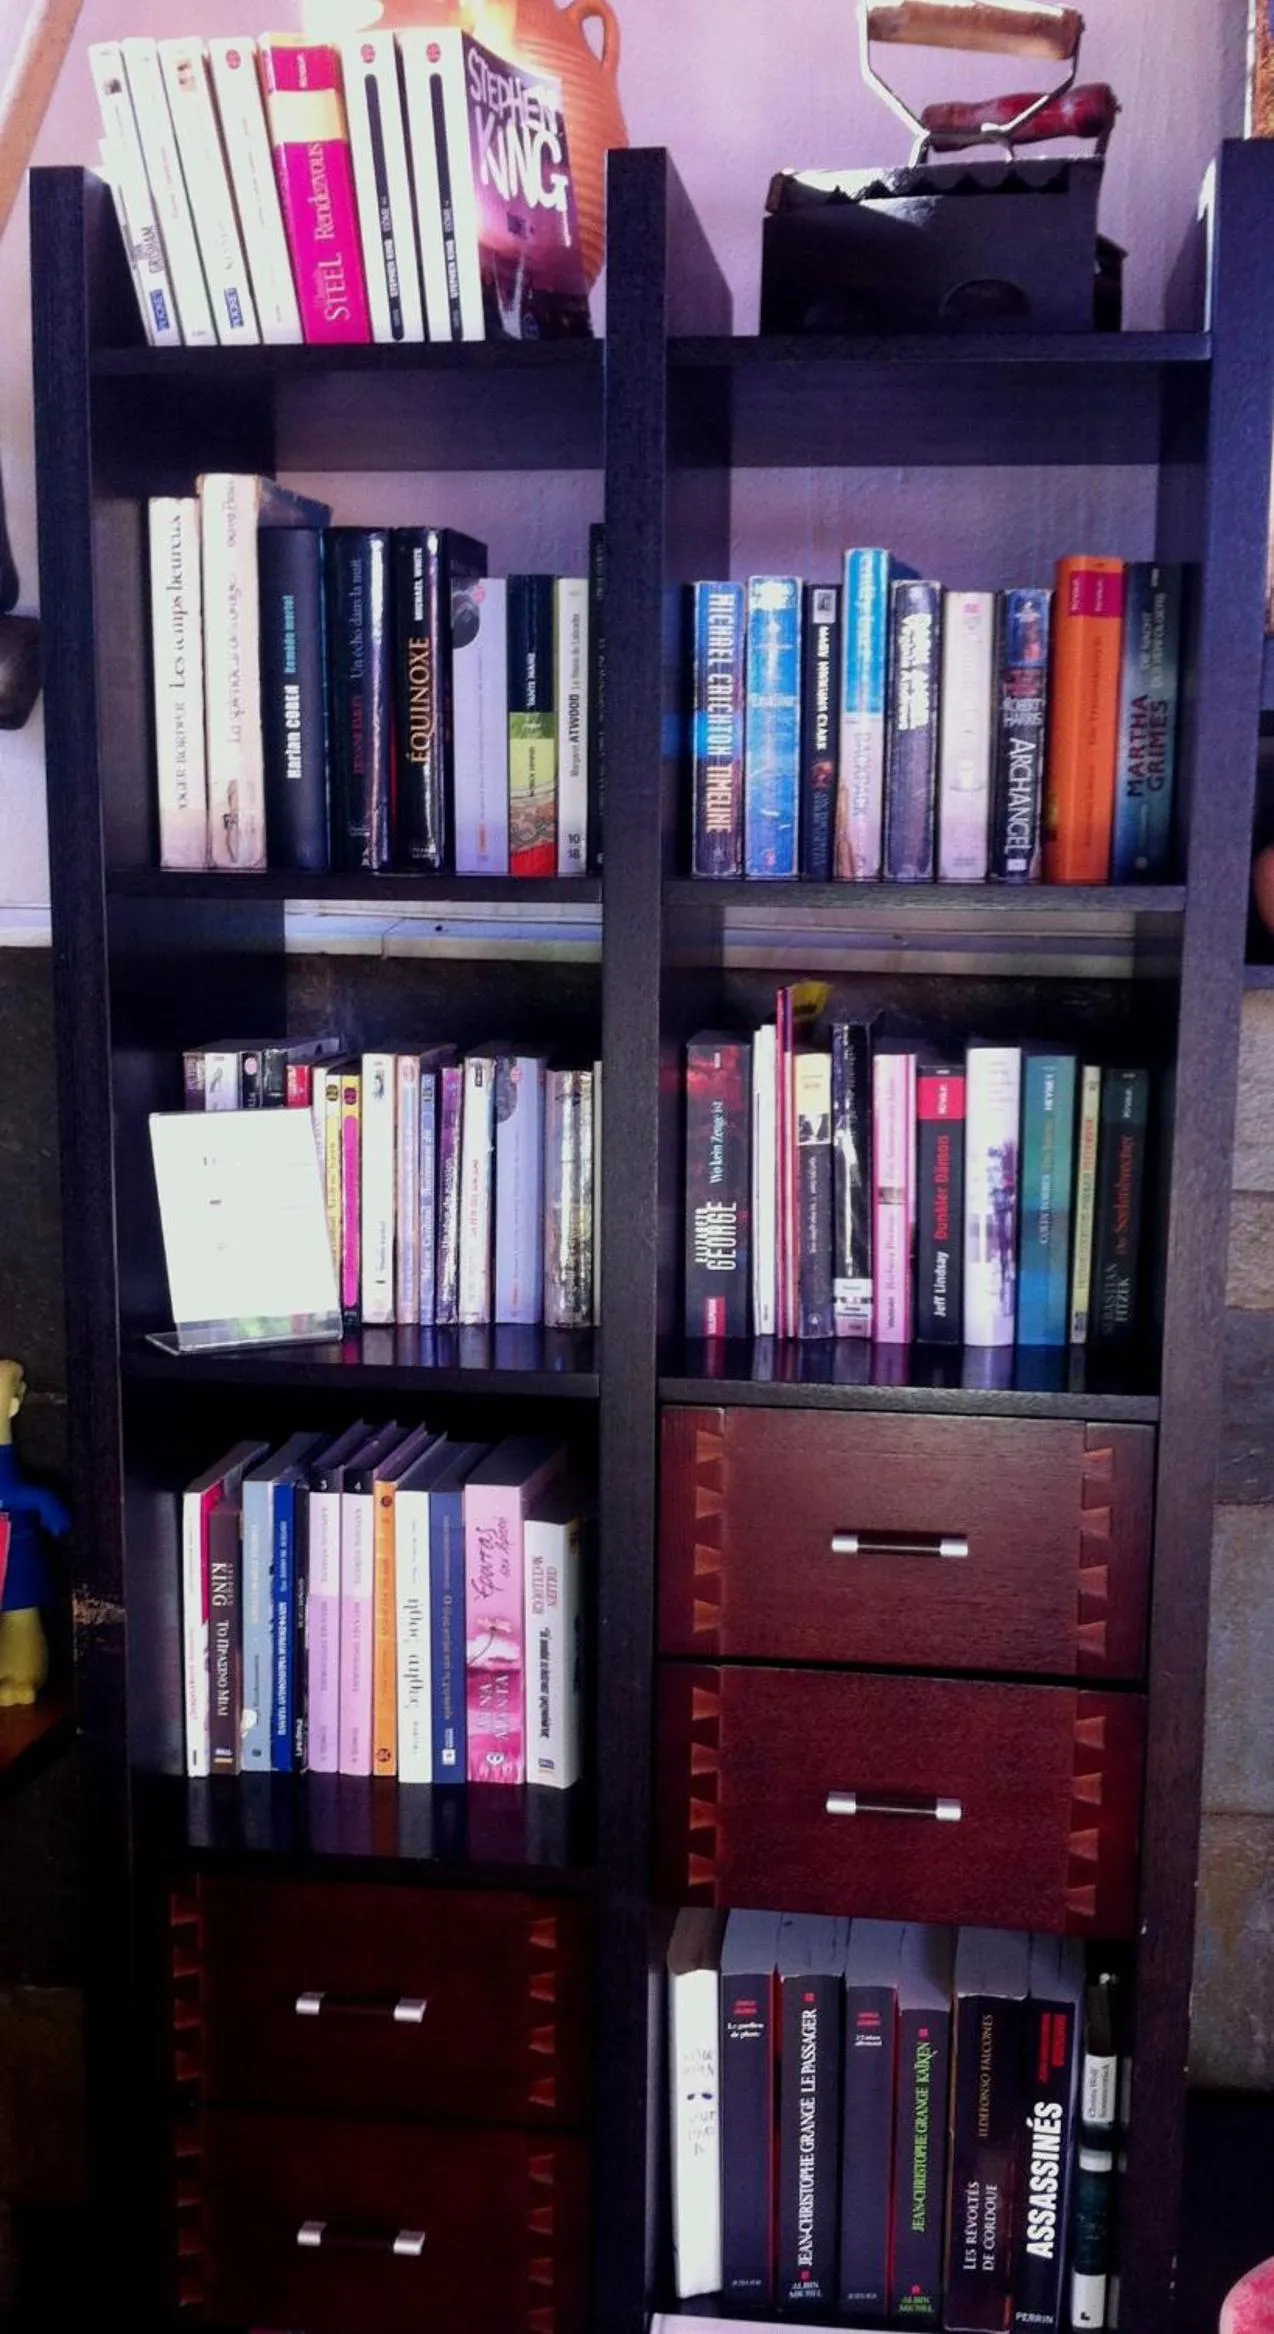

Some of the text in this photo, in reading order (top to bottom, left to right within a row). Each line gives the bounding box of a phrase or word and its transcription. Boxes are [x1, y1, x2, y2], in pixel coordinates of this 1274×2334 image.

[468, 47, 563, 135] STEPHEN
[307, 142, 335, 241] Rendezvous
[474, 106, 572, 247] KING
[383, 238, 396, 260] KING
[444, 239, 459, 299] STEPHEN KING
[324, 252, 351, 322] STEEL
[412, 546, 425, 621] MICHAEL WHITE
[168, 656, 185, 689] Les
[348, 659, 364, 679] Un
[706, 593, 736, 756] MICHAEL CRICHTON
[816, 625, 831, 657] MARY
[283, 684, 303, 779] Harlan COBEN
[404, 636, 432, 764] ÉQUINOXE
[567, 693, 581, 743] ATWOOD
[815, 713, 830, 751] CLARK
[1125, 693, 1149, 798] MARTHA
[1145, 698, 1169, 792] GRIMES
[705, 763, 733, 834] TIMELINE
[1003, 736, 1037, 855] ARCHANGEL
[708, 1144, 723, 1165] kein
[709, 1115, 726, 1143] Zeuge
[708, 1165, 724, 1184] Wo
[931, 1134, 949, 1240] Dunkler Dämon
[694, 1207, 708, 1263] ELIZABETH
[705, 1200, 738, 1271] GEORGE
[932, 1251, 950, 1317] Jeff Lindsay
[211, 1561, 228, 1607] KING
[802, 2008, 818, 2093] LE PASSAGER
[913, 2041, 936, 2083] KAÏKEN
[976, 2013, 994, 2138] ILDEFONSO FALCONES
[797, 2152, 815, 2267] JEAN-CHRISTOPHE
[911, 2133, 928, 2232] JEAN-CHRISTOPHE
[1026, 2100, 1063, 2259] ASSASSINÉS
[961, 2180, 980, 2270] LES RÉVOLTÉS
[982, 2182, 999, 2271] DE CORDOUE
[1015, 2311, 1055, 2325] PERRIN
